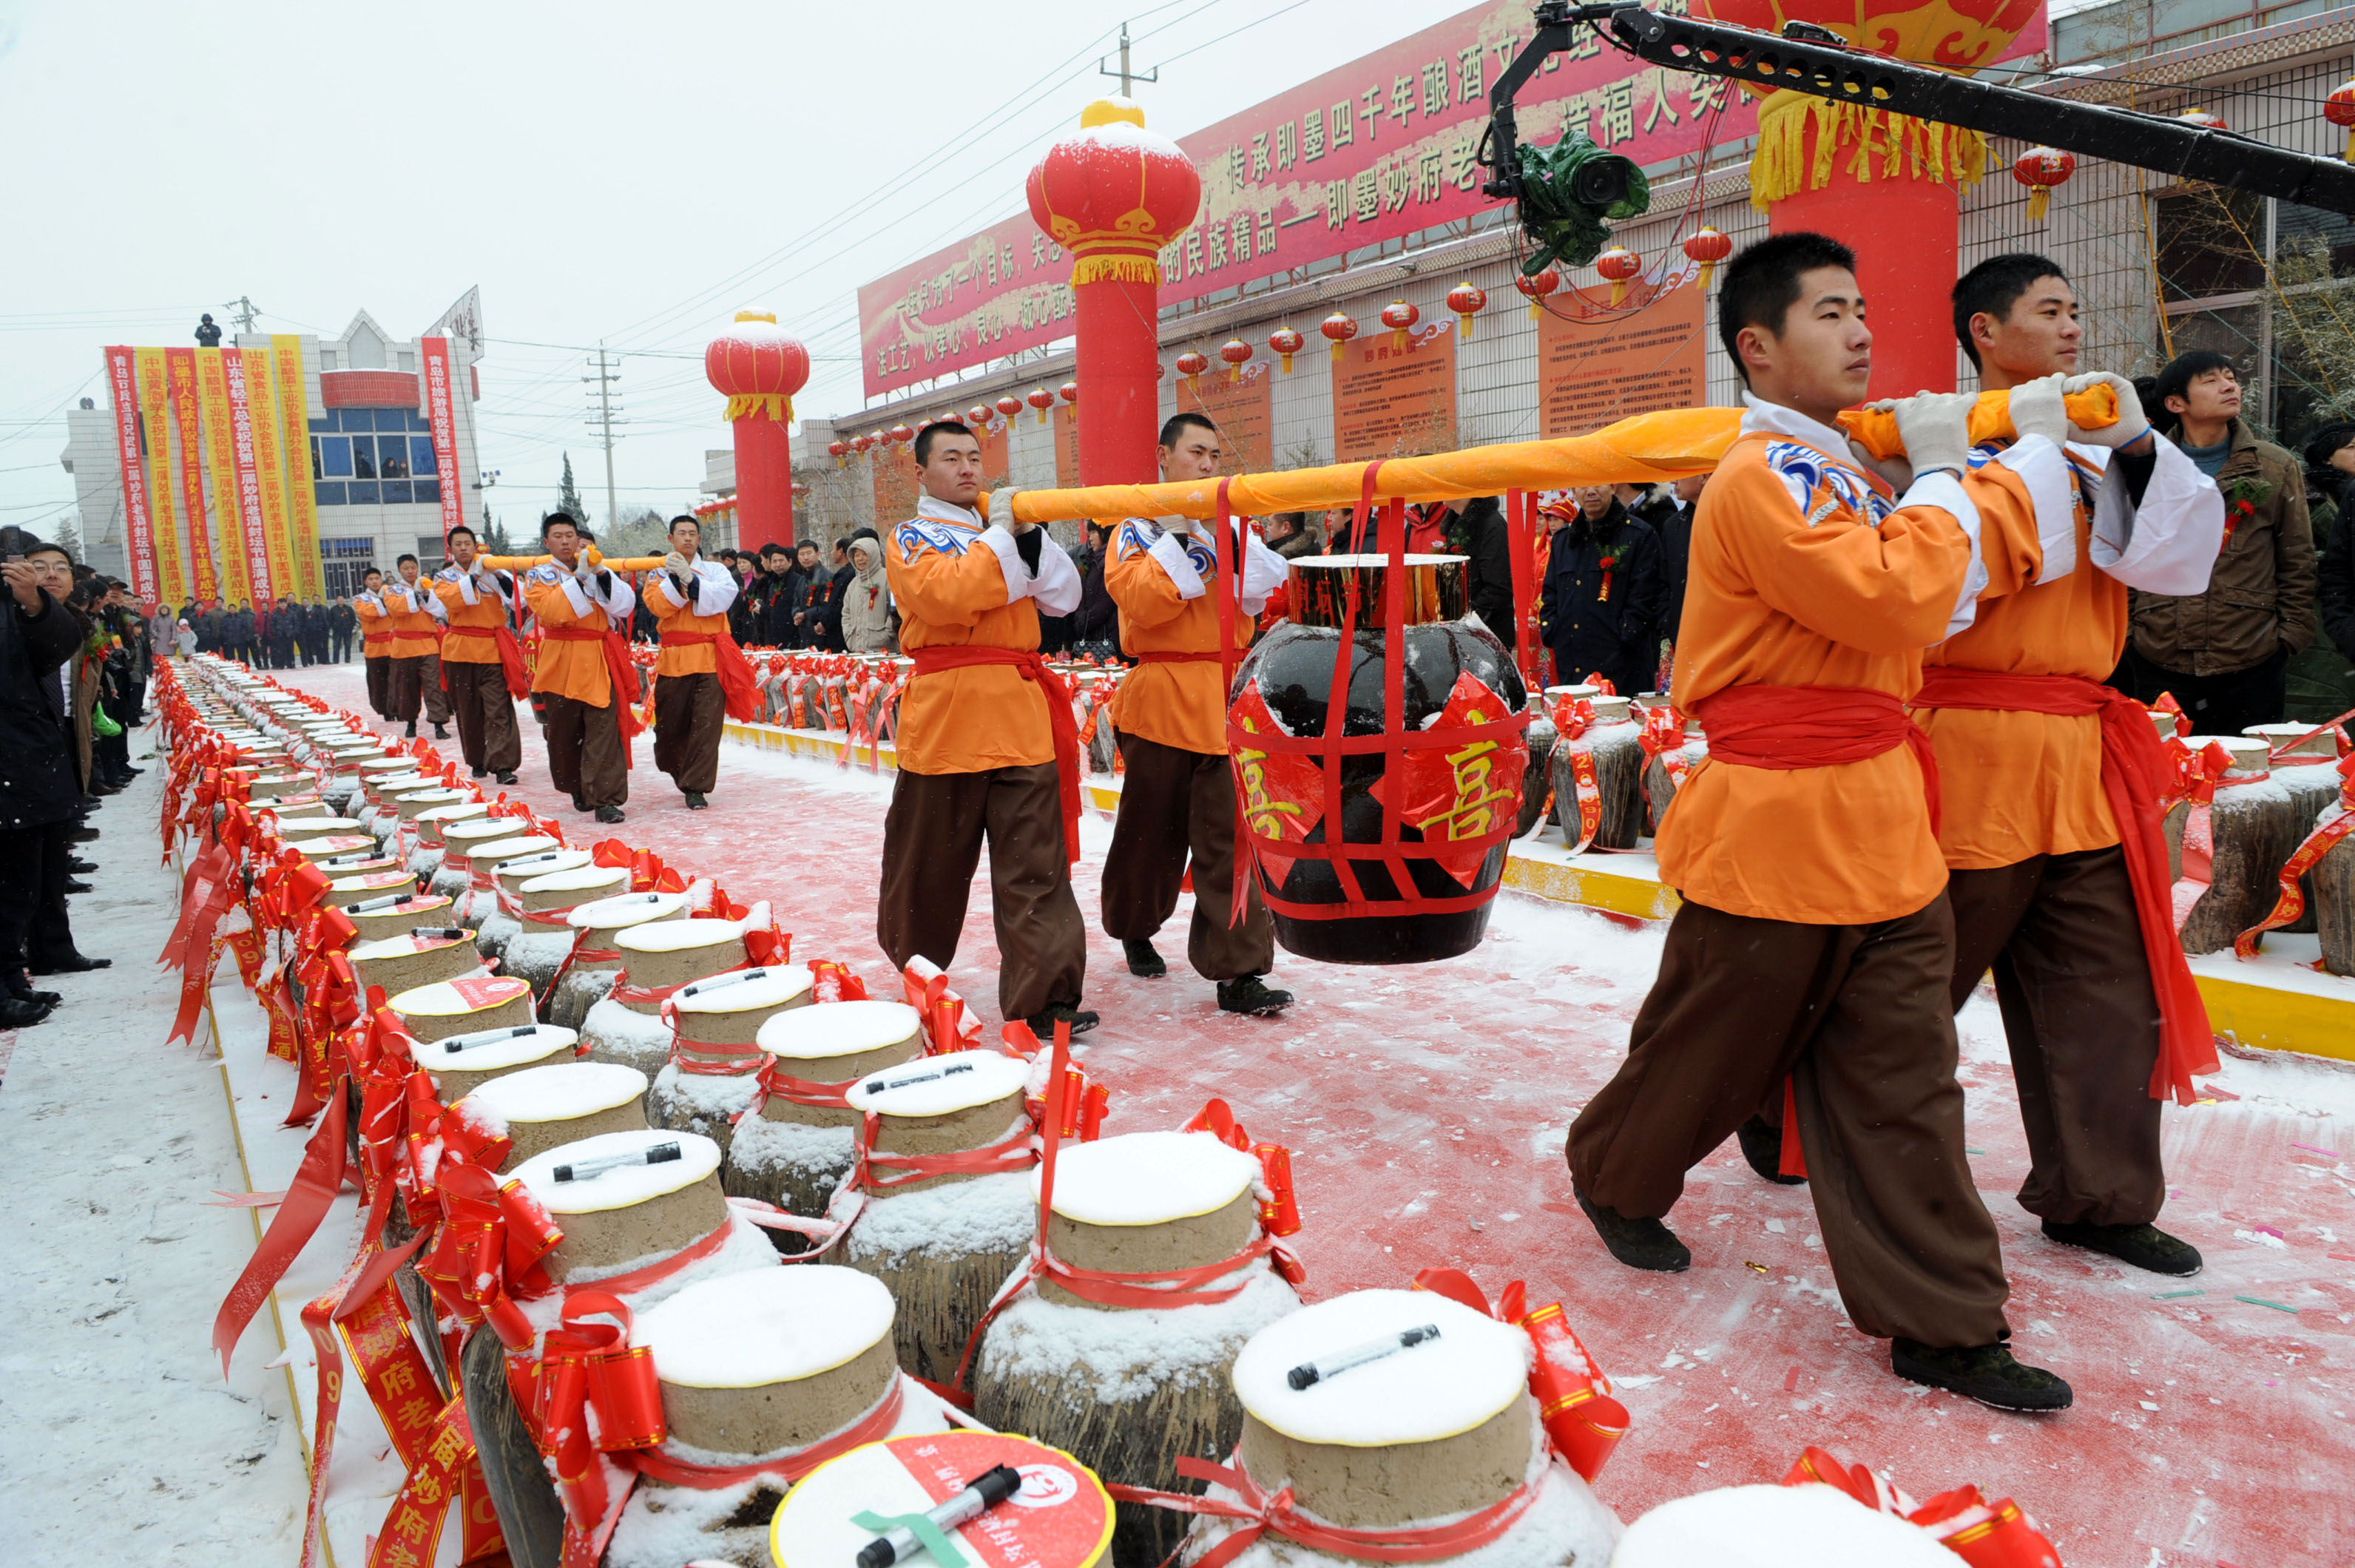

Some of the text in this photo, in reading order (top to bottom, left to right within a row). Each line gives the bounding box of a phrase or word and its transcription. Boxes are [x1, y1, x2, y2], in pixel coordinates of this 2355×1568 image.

[226, 356, 270, 600] 山东省轻工总会祝贺第二届妙府老酒封坛节圆满成功
